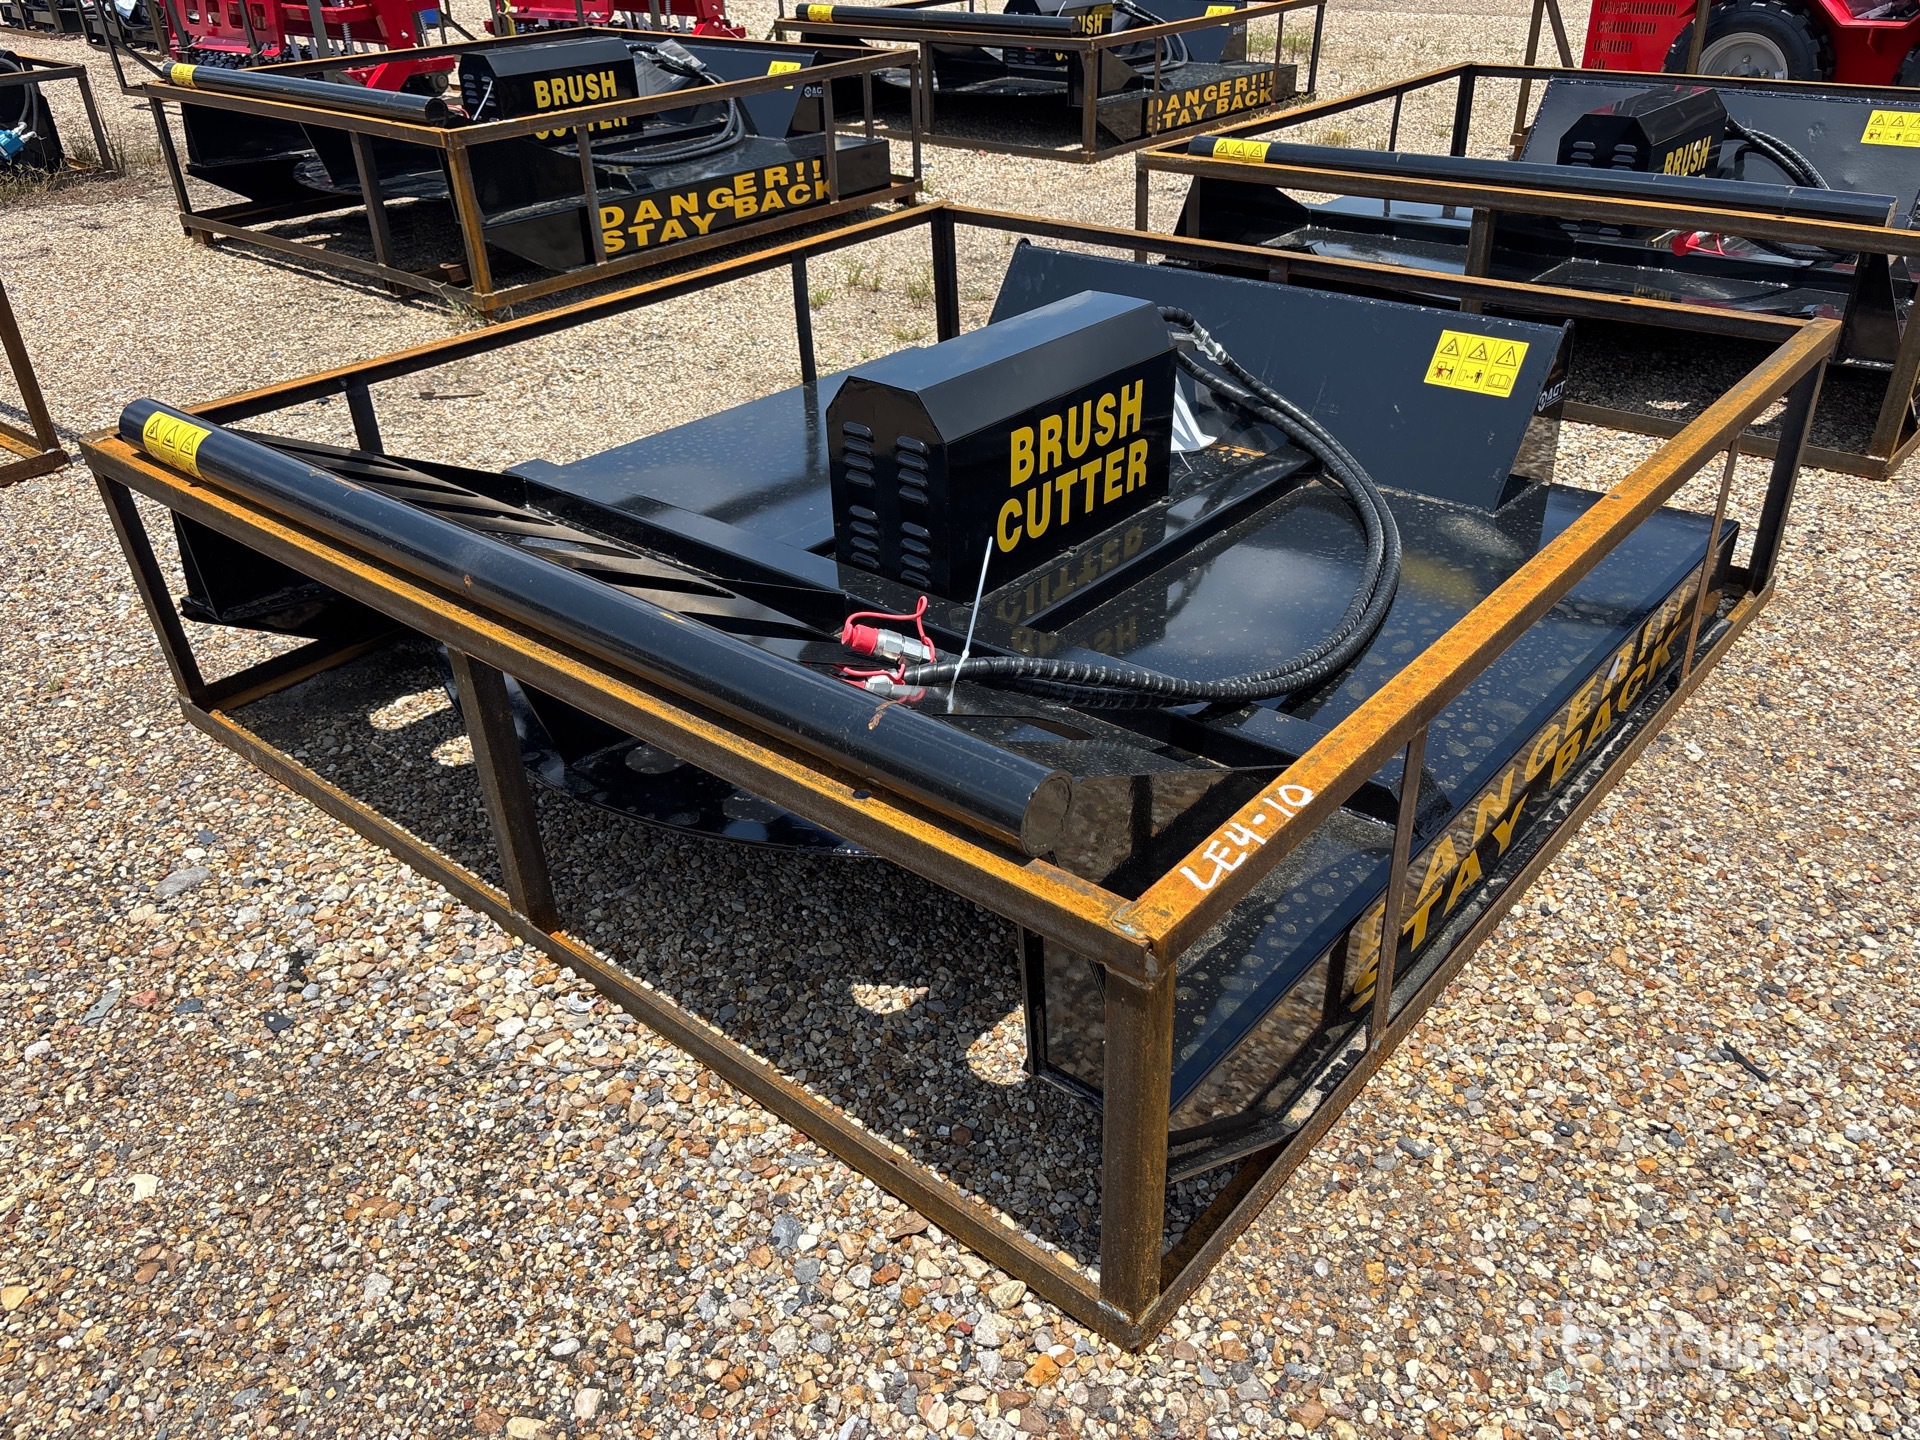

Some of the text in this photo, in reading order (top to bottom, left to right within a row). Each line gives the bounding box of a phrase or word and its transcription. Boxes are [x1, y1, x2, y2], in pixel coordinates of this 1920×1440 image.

[534, 71, 618, 109] BRUSH
[1216, 87, 1272, 115] BACK
[1663, 135, 1712, 177] BRUSH
[602, 180, 829, 254] STAY BACK
[1011, 379, 1143, 488] BRUSH
[997, 438, 1148, 553] CUTTER
[1550, 624, 1682, 789] BACK
[1179, 784, 1315, 891] LE4-10
